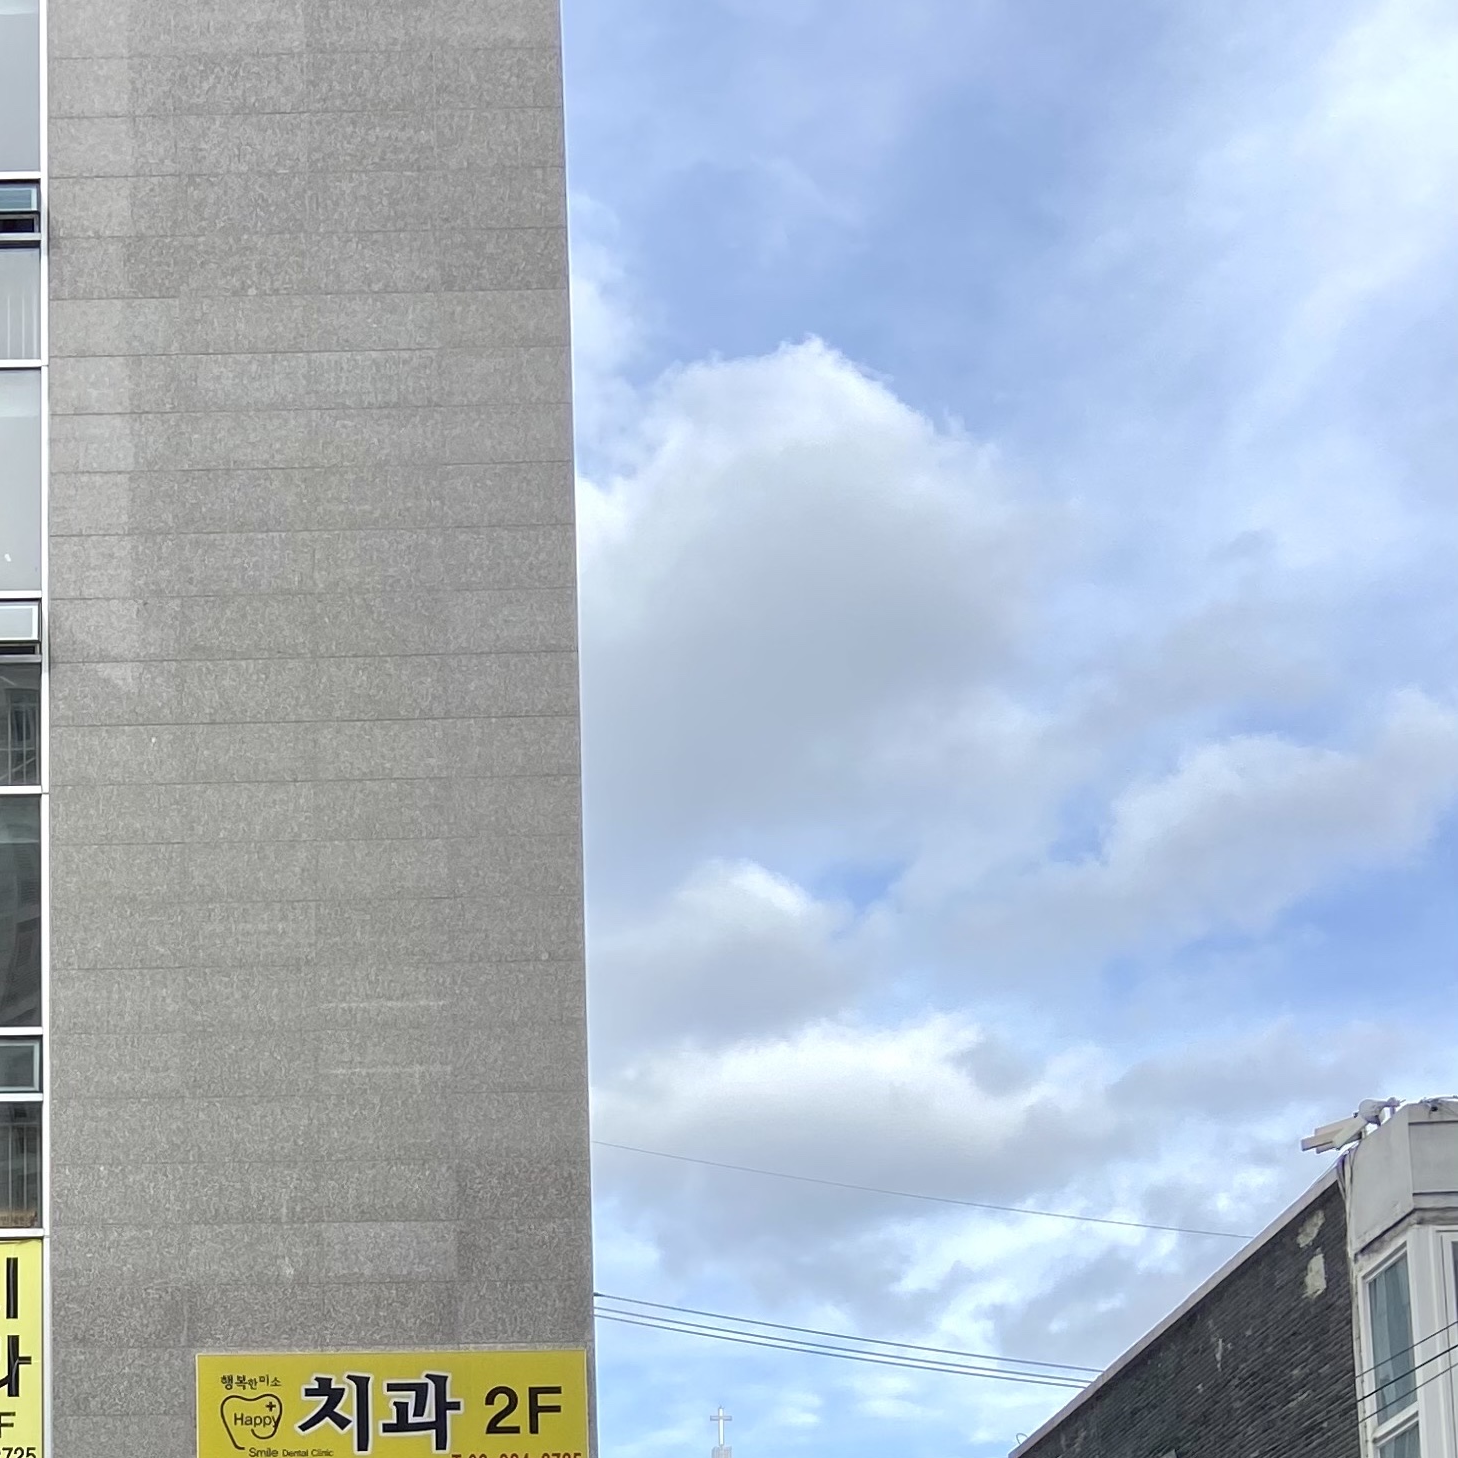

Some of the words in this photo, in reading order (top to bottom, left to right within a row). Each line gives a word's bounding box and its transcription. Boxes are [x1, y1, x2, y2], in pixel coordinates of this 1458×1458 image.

[234, 1412, 281, 1428] Happy
[297, 1373, 463, 1452] 치과
[484, 1386, 562, 1435] 2F
[249, 1447, 278, 1458] Smile
